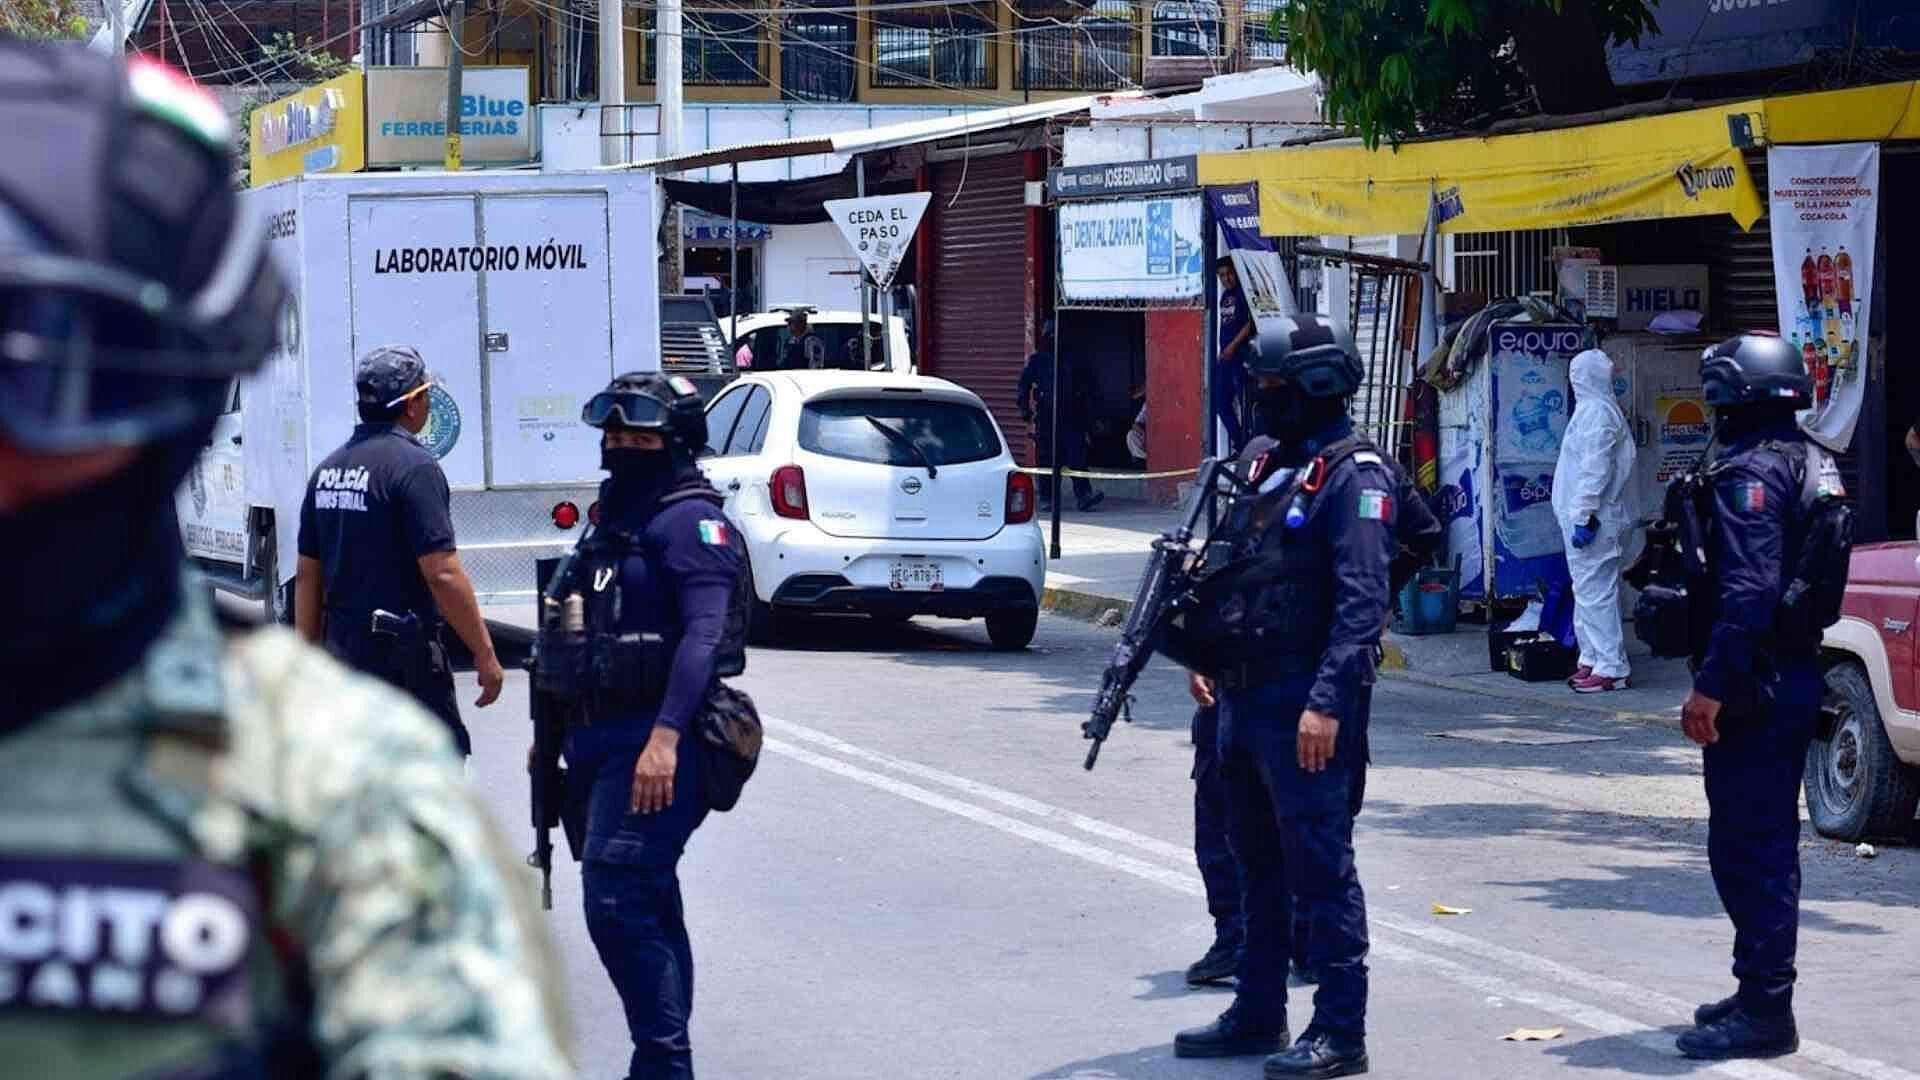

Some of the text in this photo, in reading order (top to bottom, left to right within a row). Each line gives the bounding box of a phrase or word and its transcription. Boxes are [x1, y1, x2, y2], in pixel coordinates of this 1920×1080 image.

[460, 96, 524, 117] Blue
[382, 121, 518, 136] FERREERIAS
[848, 207, 908, 224] CEDA EL
[860, 225, 899, 240] PASO
[1074, 217, 1144, 248] DENTAL ZAPATA
[374, 237, 587, 273] LABORATORIO MÓVIL
[1625, 287, 1701, 312] HIELO
[316, 465, 370, 492] POLICÍA
